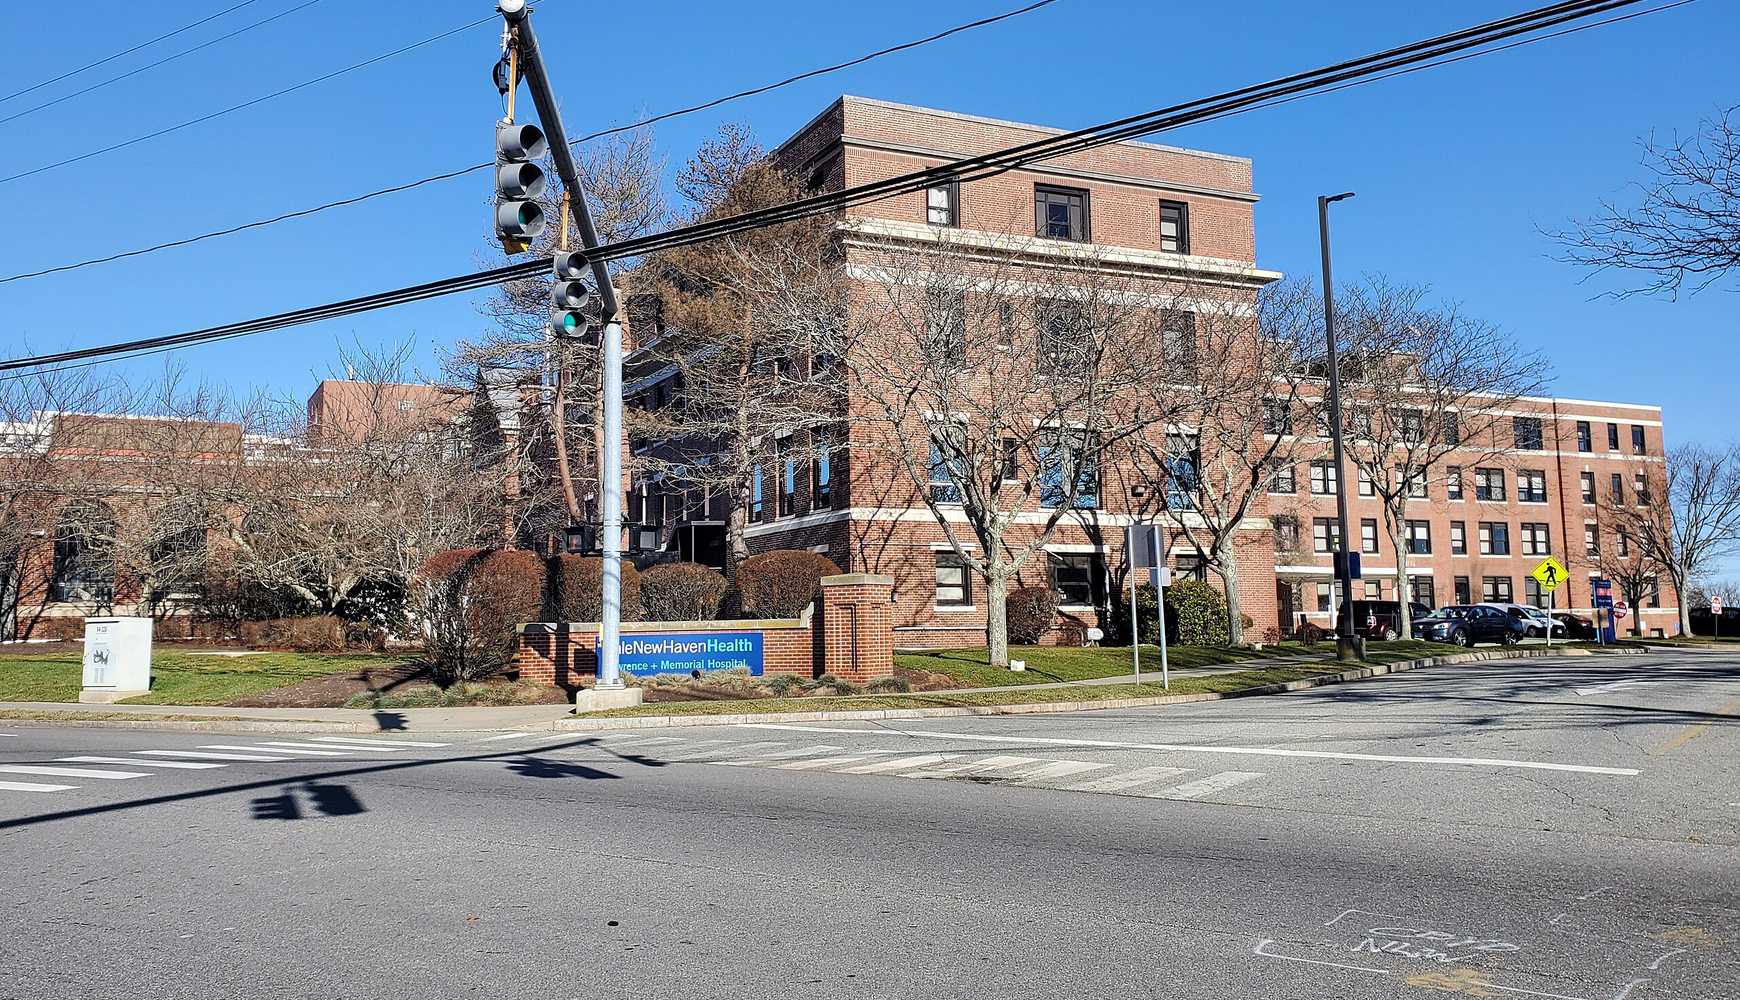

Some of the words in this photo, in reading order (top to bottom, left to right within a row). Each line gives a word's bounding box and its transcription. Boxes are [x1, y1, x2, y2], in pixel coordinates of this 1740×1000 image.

[618, 639, 753, 654] leNewHavenHealth
[661, 660, 704, 670] Memorial
[707, 659, 746, 669] Hospital
